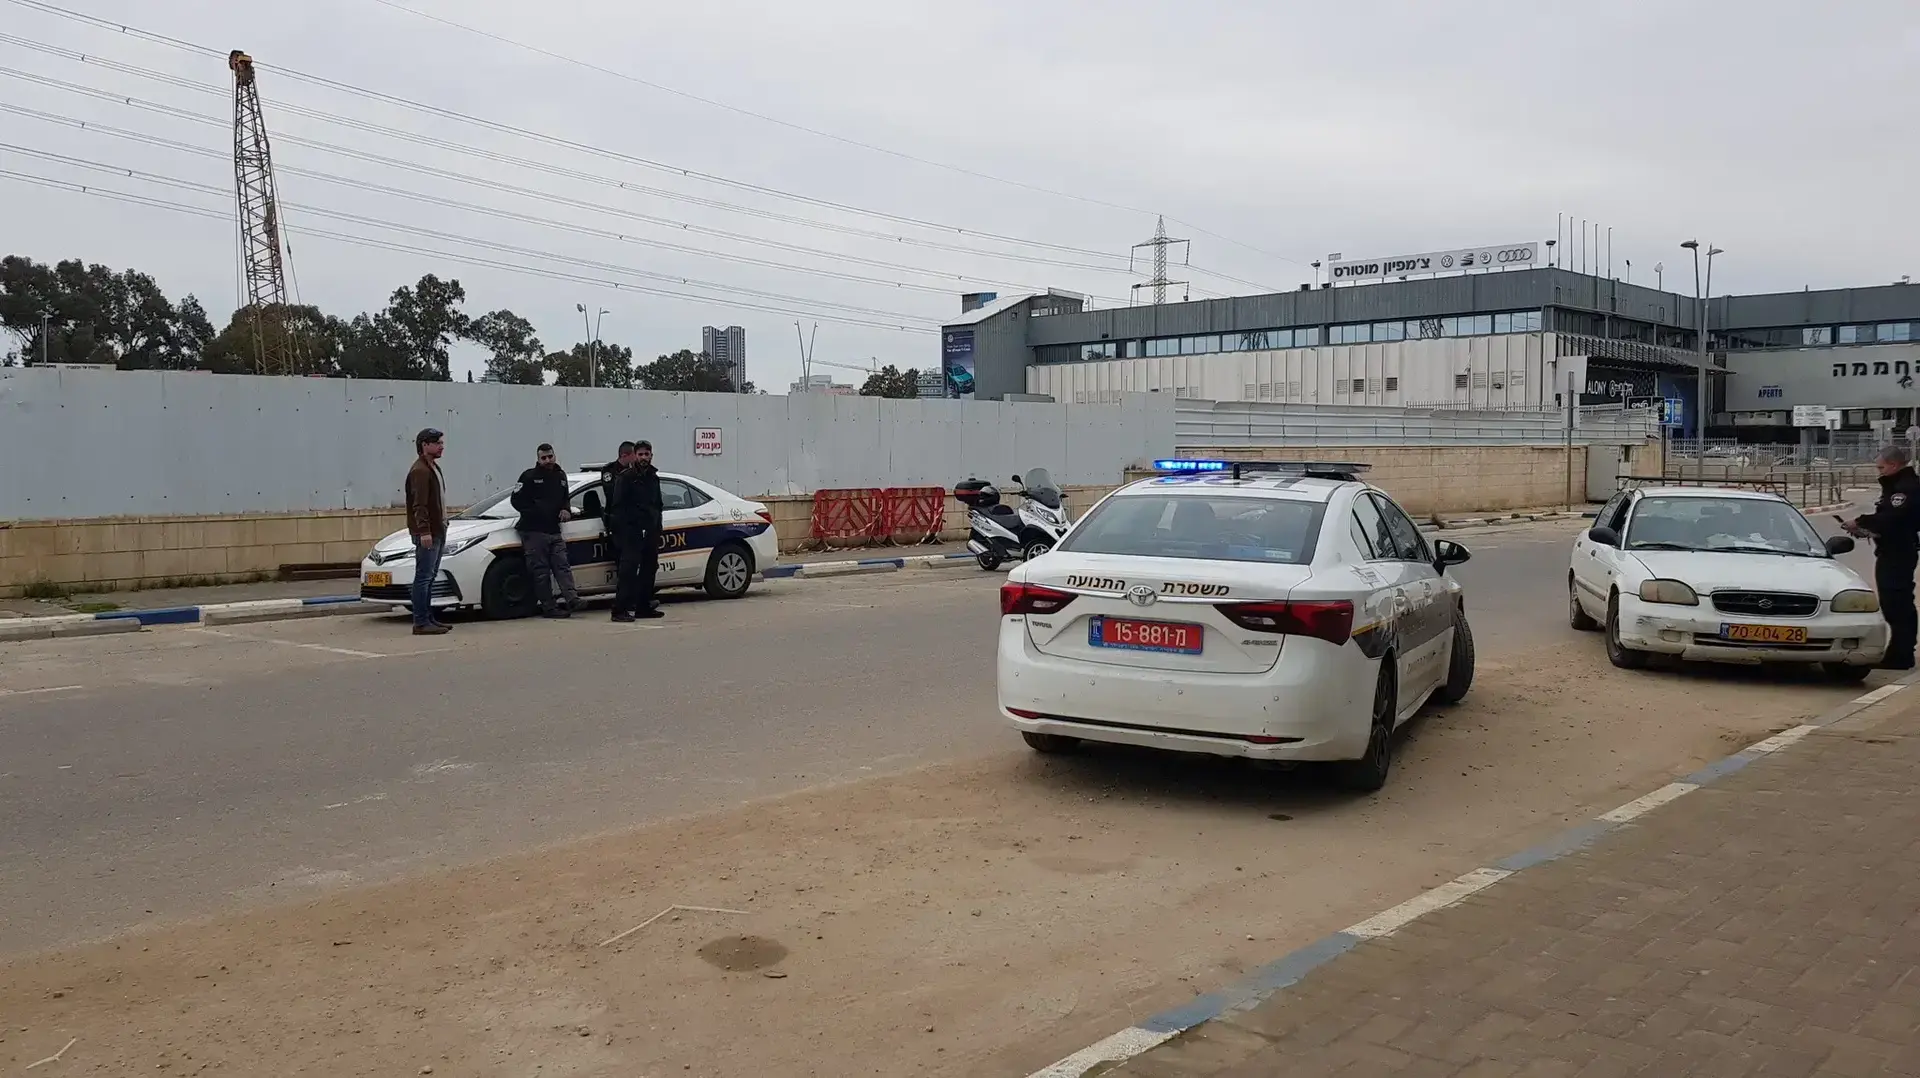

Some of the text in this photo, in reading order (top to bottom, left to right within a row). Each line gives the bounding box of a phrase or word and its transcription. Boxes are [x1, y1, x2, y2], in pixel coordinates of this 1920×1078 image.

[1334, 263, 1379, 277] מוטורס
[1587, 380, 1607, 395] ALONY
[701, 432, 716, 440] סכנה
[1067, 574, 1230, 596] משטרת התנועה
